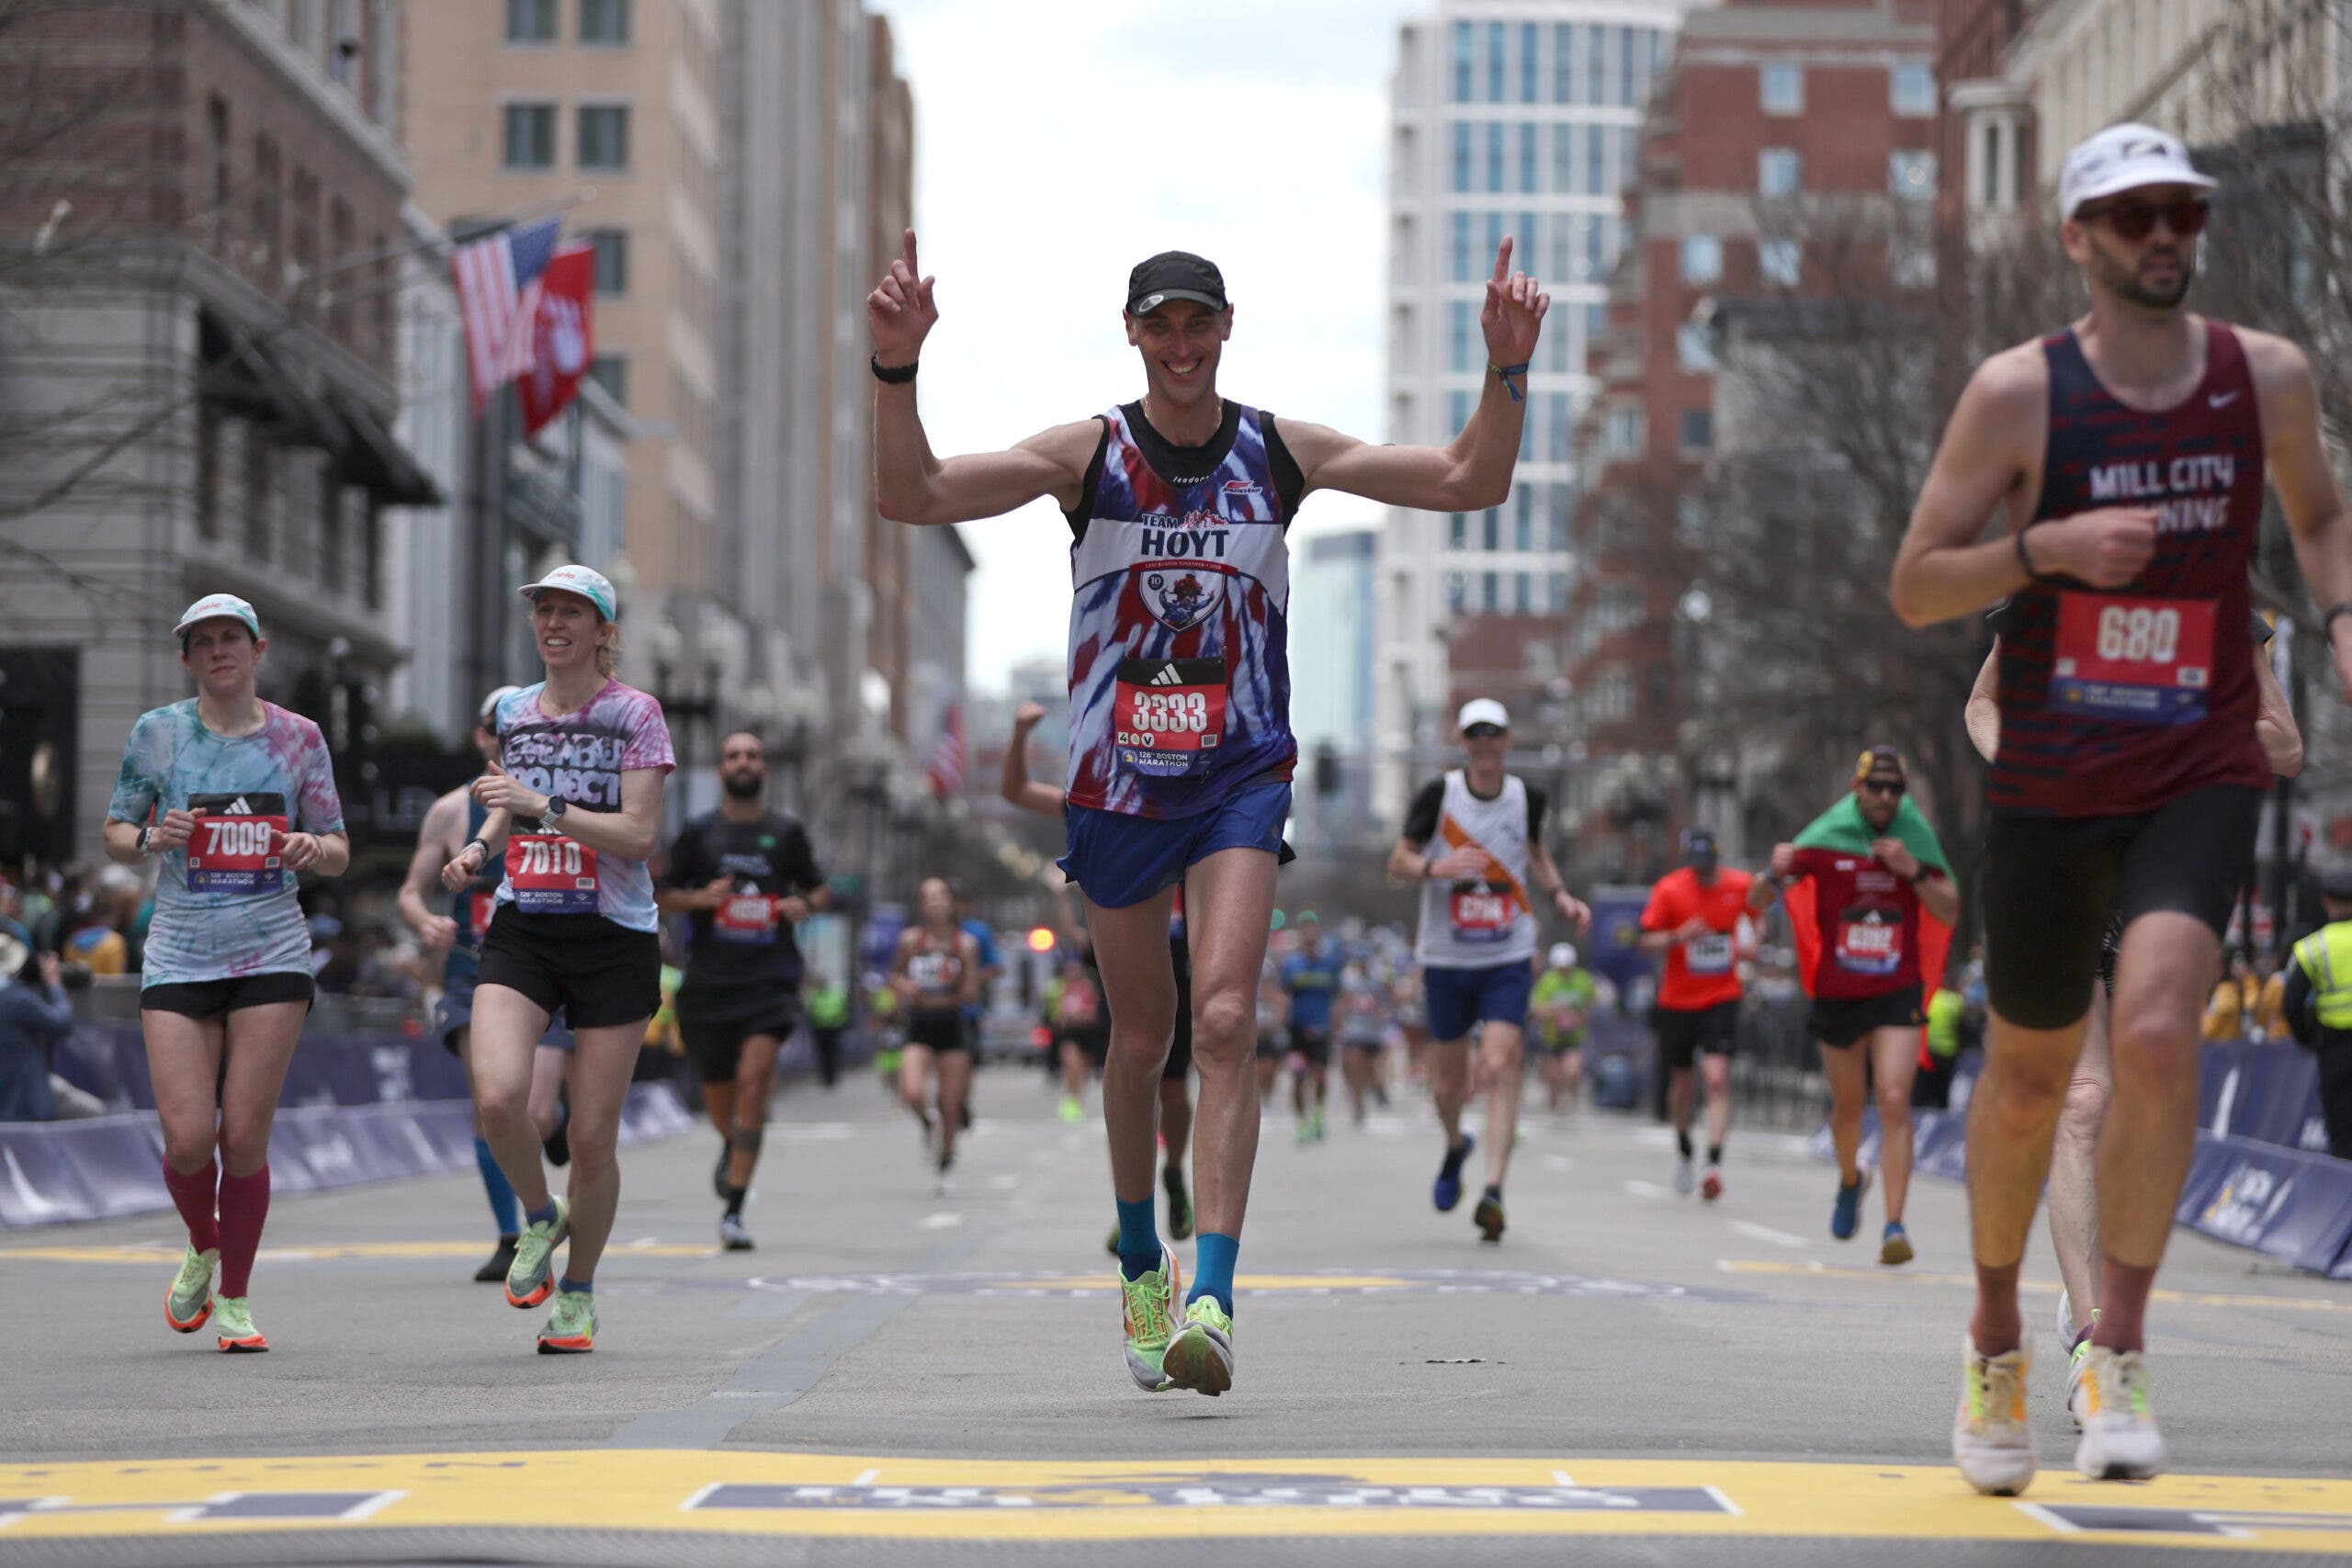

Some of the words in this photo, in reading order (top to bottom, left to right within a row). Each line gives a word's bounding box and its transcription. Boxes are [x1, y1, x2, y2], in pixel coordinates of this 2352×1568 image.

[2089, 461, 2165, 500] MILL
[2169, 454, 2235, 492] CITY
[1141, 513, 1179, 529] TEAM
[1141, 528, 1229, 558] HOYT
[1150, 576, 1161, 585] 10
[2097, 605, 2180, 663] 680
[1132, 691, 1207, 733] 3333
[1119, 733, 1128, 742] 4
[1138, 759, 1189, 767] MARATHON
[1156, 752, 1188, 761] BOSTON
[204, 821, 272, 856] 7009
[519, 840, 582, 875] 7010
